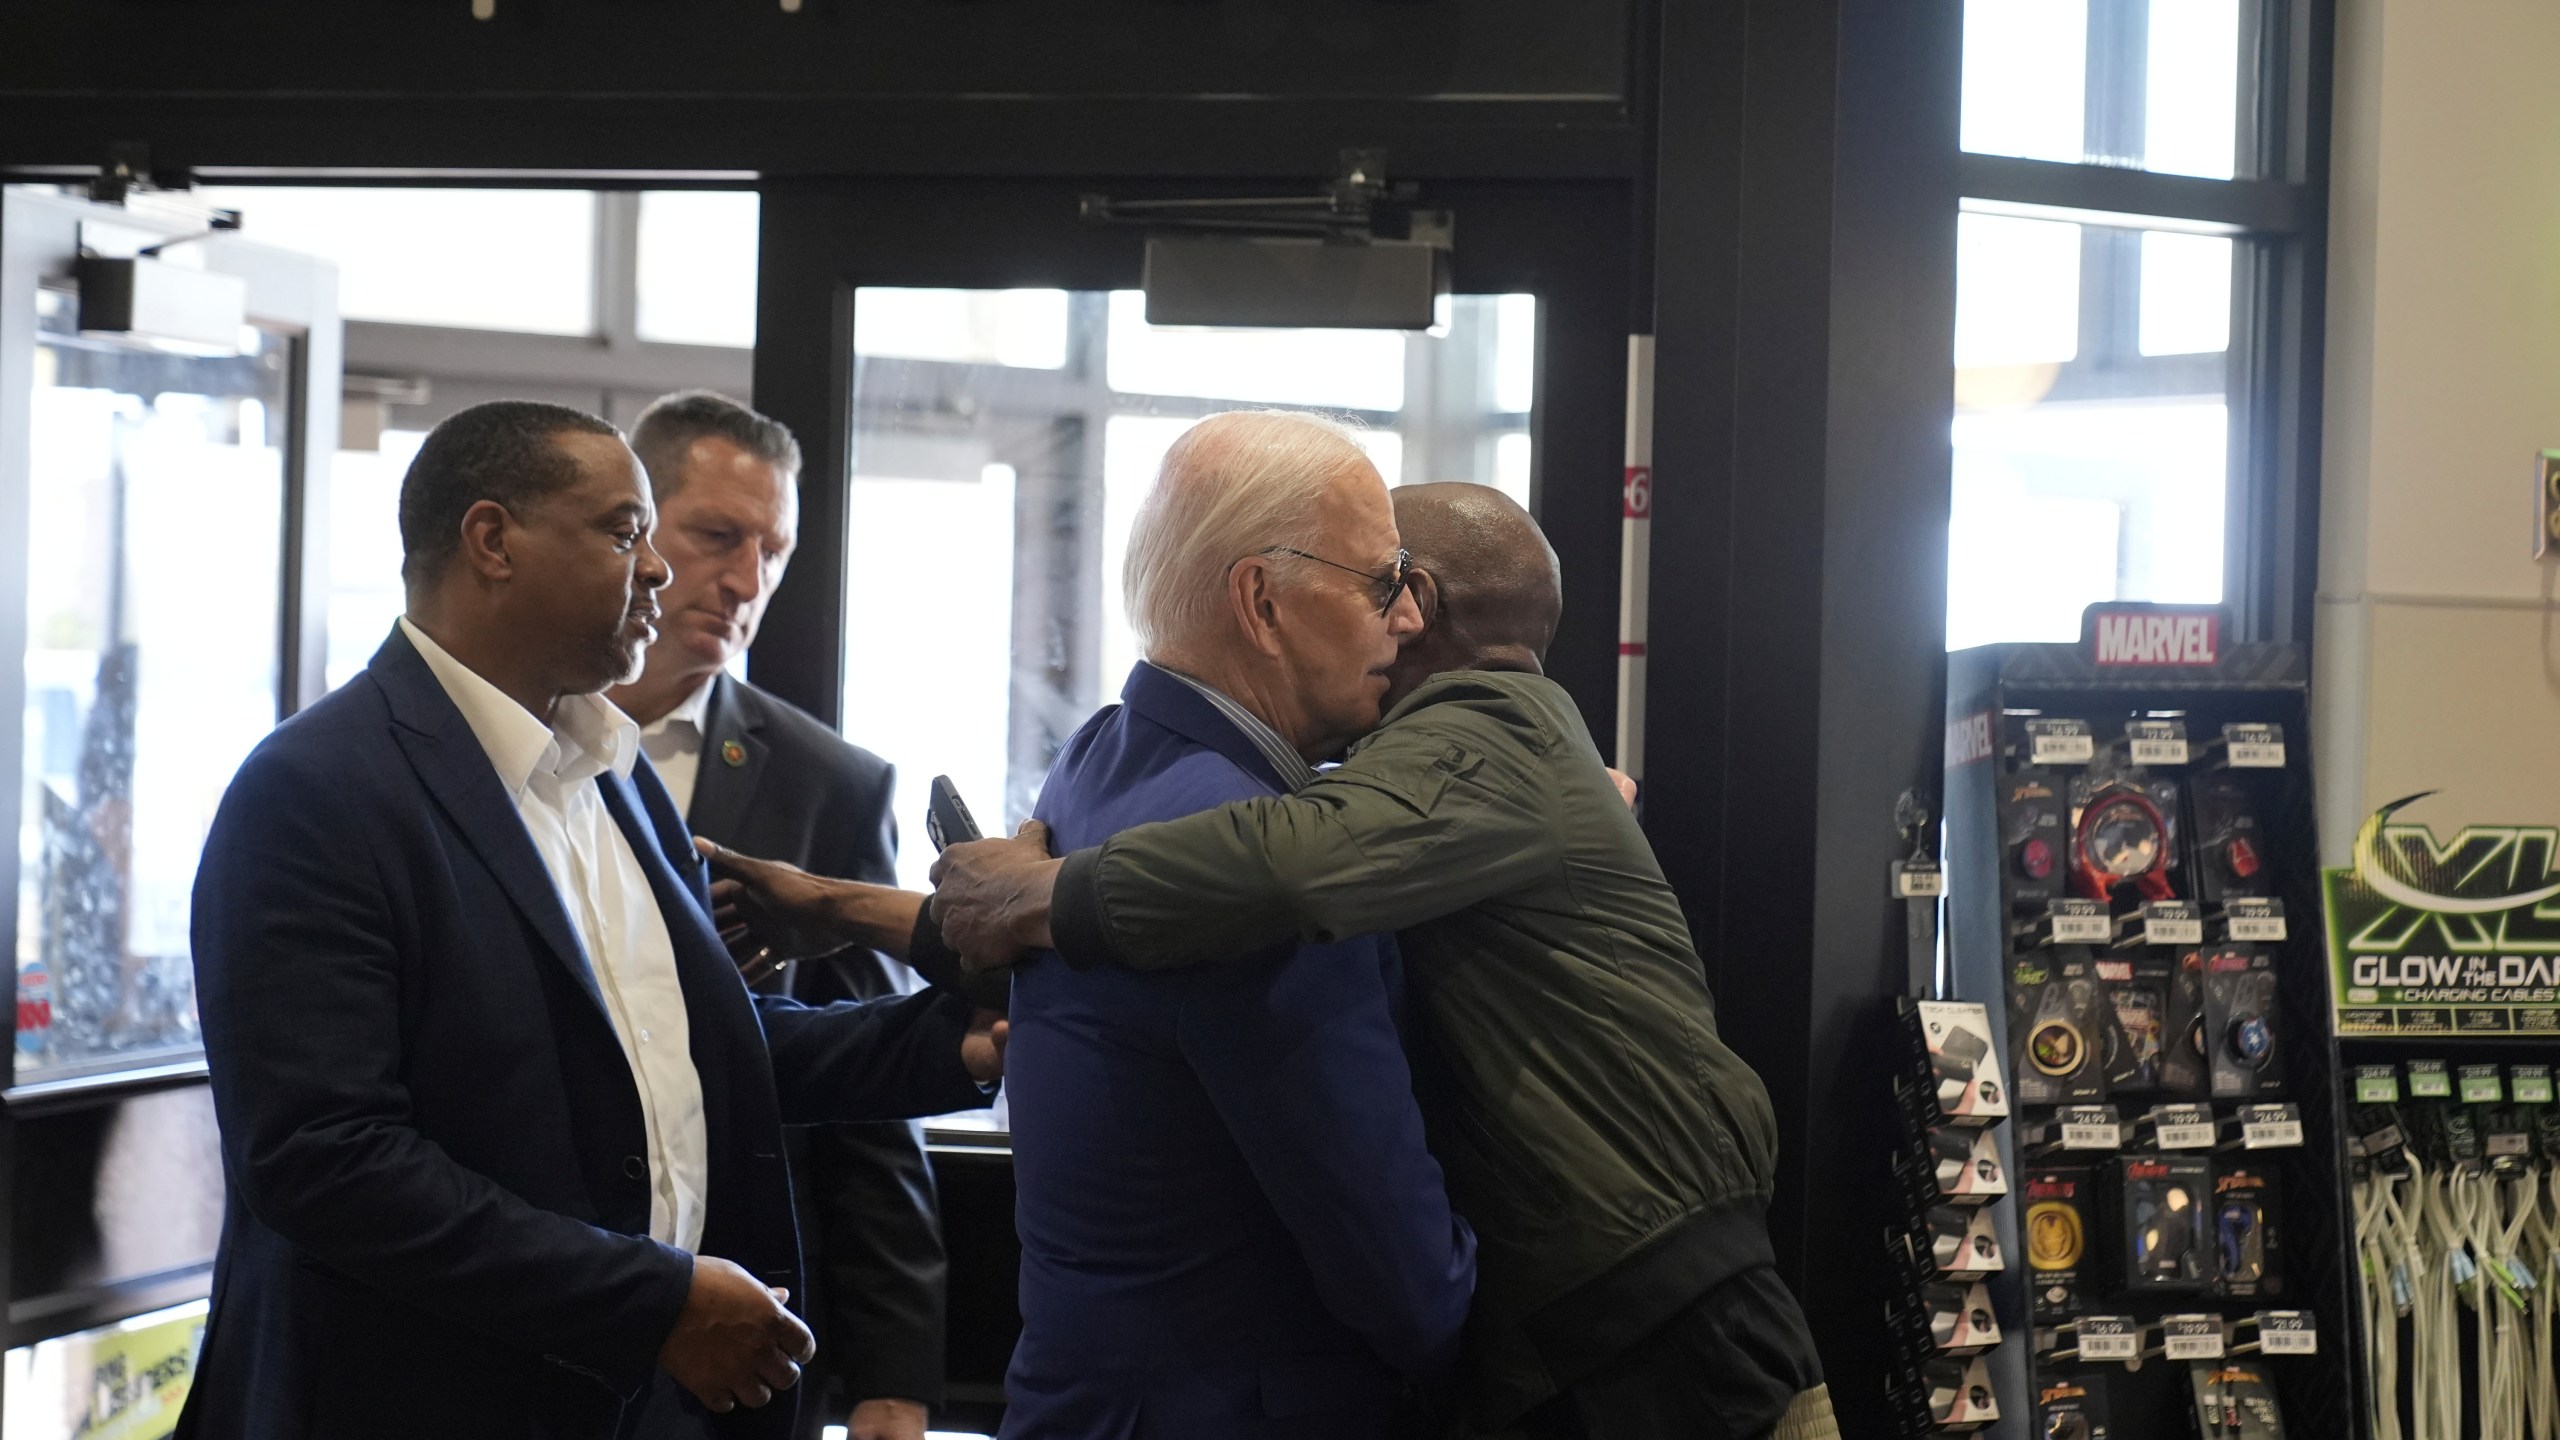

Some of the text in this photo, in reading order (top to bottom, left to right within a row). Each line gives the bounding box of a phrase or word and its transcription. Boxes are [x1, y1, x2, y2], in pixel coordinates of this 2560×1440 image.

[2098, 615, 2214, 663] MARVEL
[2353, 955, 2560, 987] GLOW IN THE DA
[2403, 988, 2556, 1002] CHARGING CABLES
[2168, 1112, 2201, 1125] $19.99
[2091, 1321, 2123, 1335] $16.99
[2178, 1323, 2210, 1336] $19.99
